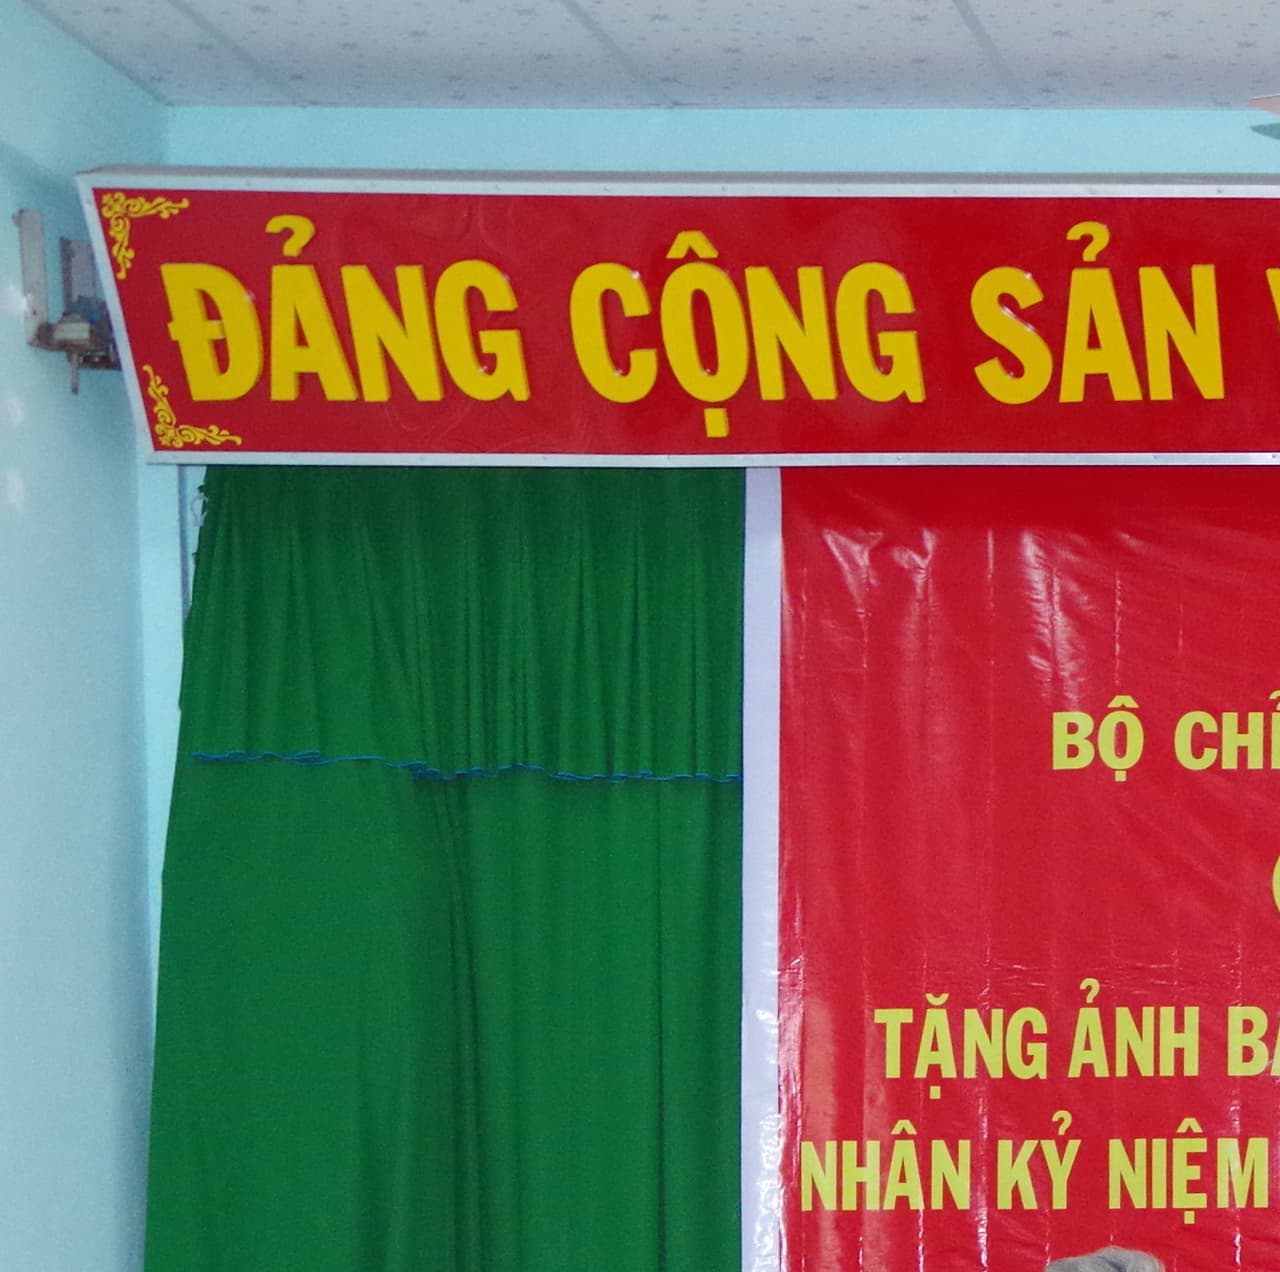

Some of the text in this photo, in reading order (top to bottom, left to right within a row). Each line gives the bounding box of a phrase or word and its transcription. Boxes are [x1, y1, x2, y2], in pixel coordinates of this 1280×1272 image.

[160, 214, 531, 402] ĐẢNG
[570, 230, 926, 438] CỘNG
[970, 221, 1225, 404] SẢN
[1052, 695, 1144, 782] BỘ
[873, 993, 1049, 1100] TẶNG
[1067, 978, 1201, 1079] ẢNH
[800, 1118, 971, 1211] NHÂN
[997, 1109, 1082, 1210] KỶ
[1108, 1117, 1270, 1224] NIỆM
